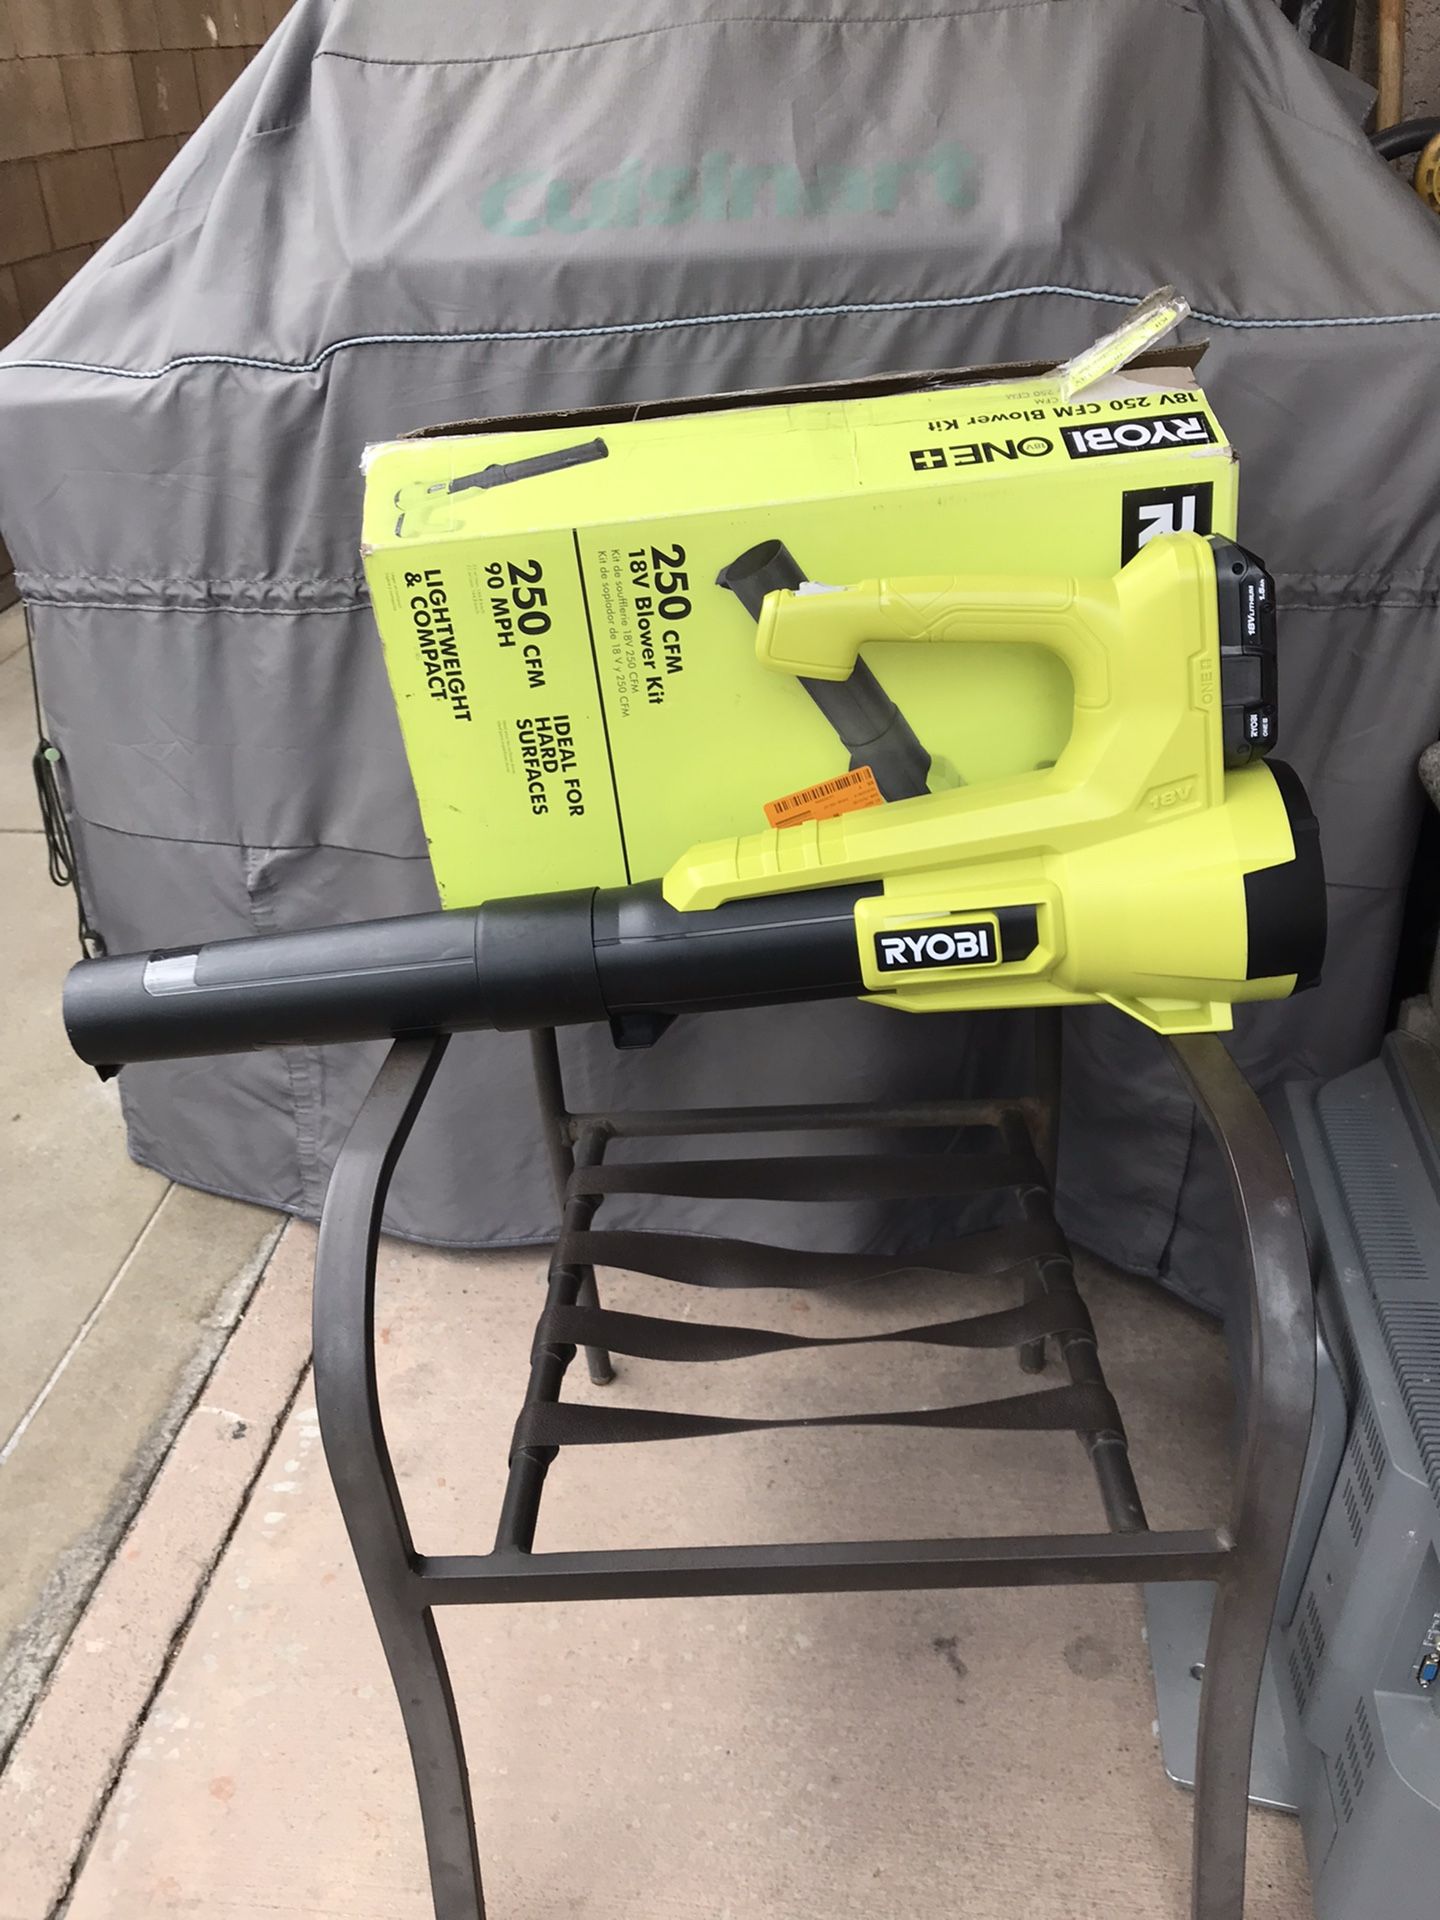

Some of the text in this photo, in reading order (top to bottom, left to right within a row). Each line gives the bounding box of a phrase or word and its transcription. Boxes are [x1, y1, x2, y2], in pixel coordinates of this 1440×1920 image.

[927, 391, 1199, 432] 18V 250 CFM Blower Kit
[1071, 416, 1209, 453] RYOBI
[598, 550, 608, 564] Kit
[611, 549, 621, 563] Kit
[484, 561, 517, 648] 90 MPH
[650, 543, 692, 674] 250 CFM
[404, 571, 448, 700] & COMPACT
[507, 559, 552, 689] 250 CFM
[623, 629, 634, 648] 18V
[628, 548, 665, 704] 18V Blower Kit
[424, 568, 472, 723] LIGHTWEIGHT
[611, 643, 622, 655] 18
[625, 649, 637, 669] 250
[616, 674, 628, 694] 250
[629, 671, 640, 694] CFM
[619, 695, 631, 718] CFM
[1250, 713, 1259, 739] RYOBI
[534, 716, 559, 774] HARD
[516, 718, 549, 816] SURFACES
[553, 714, 585, 817] IDEAL FOR
[880, 930, 990, 965] RYOBI
